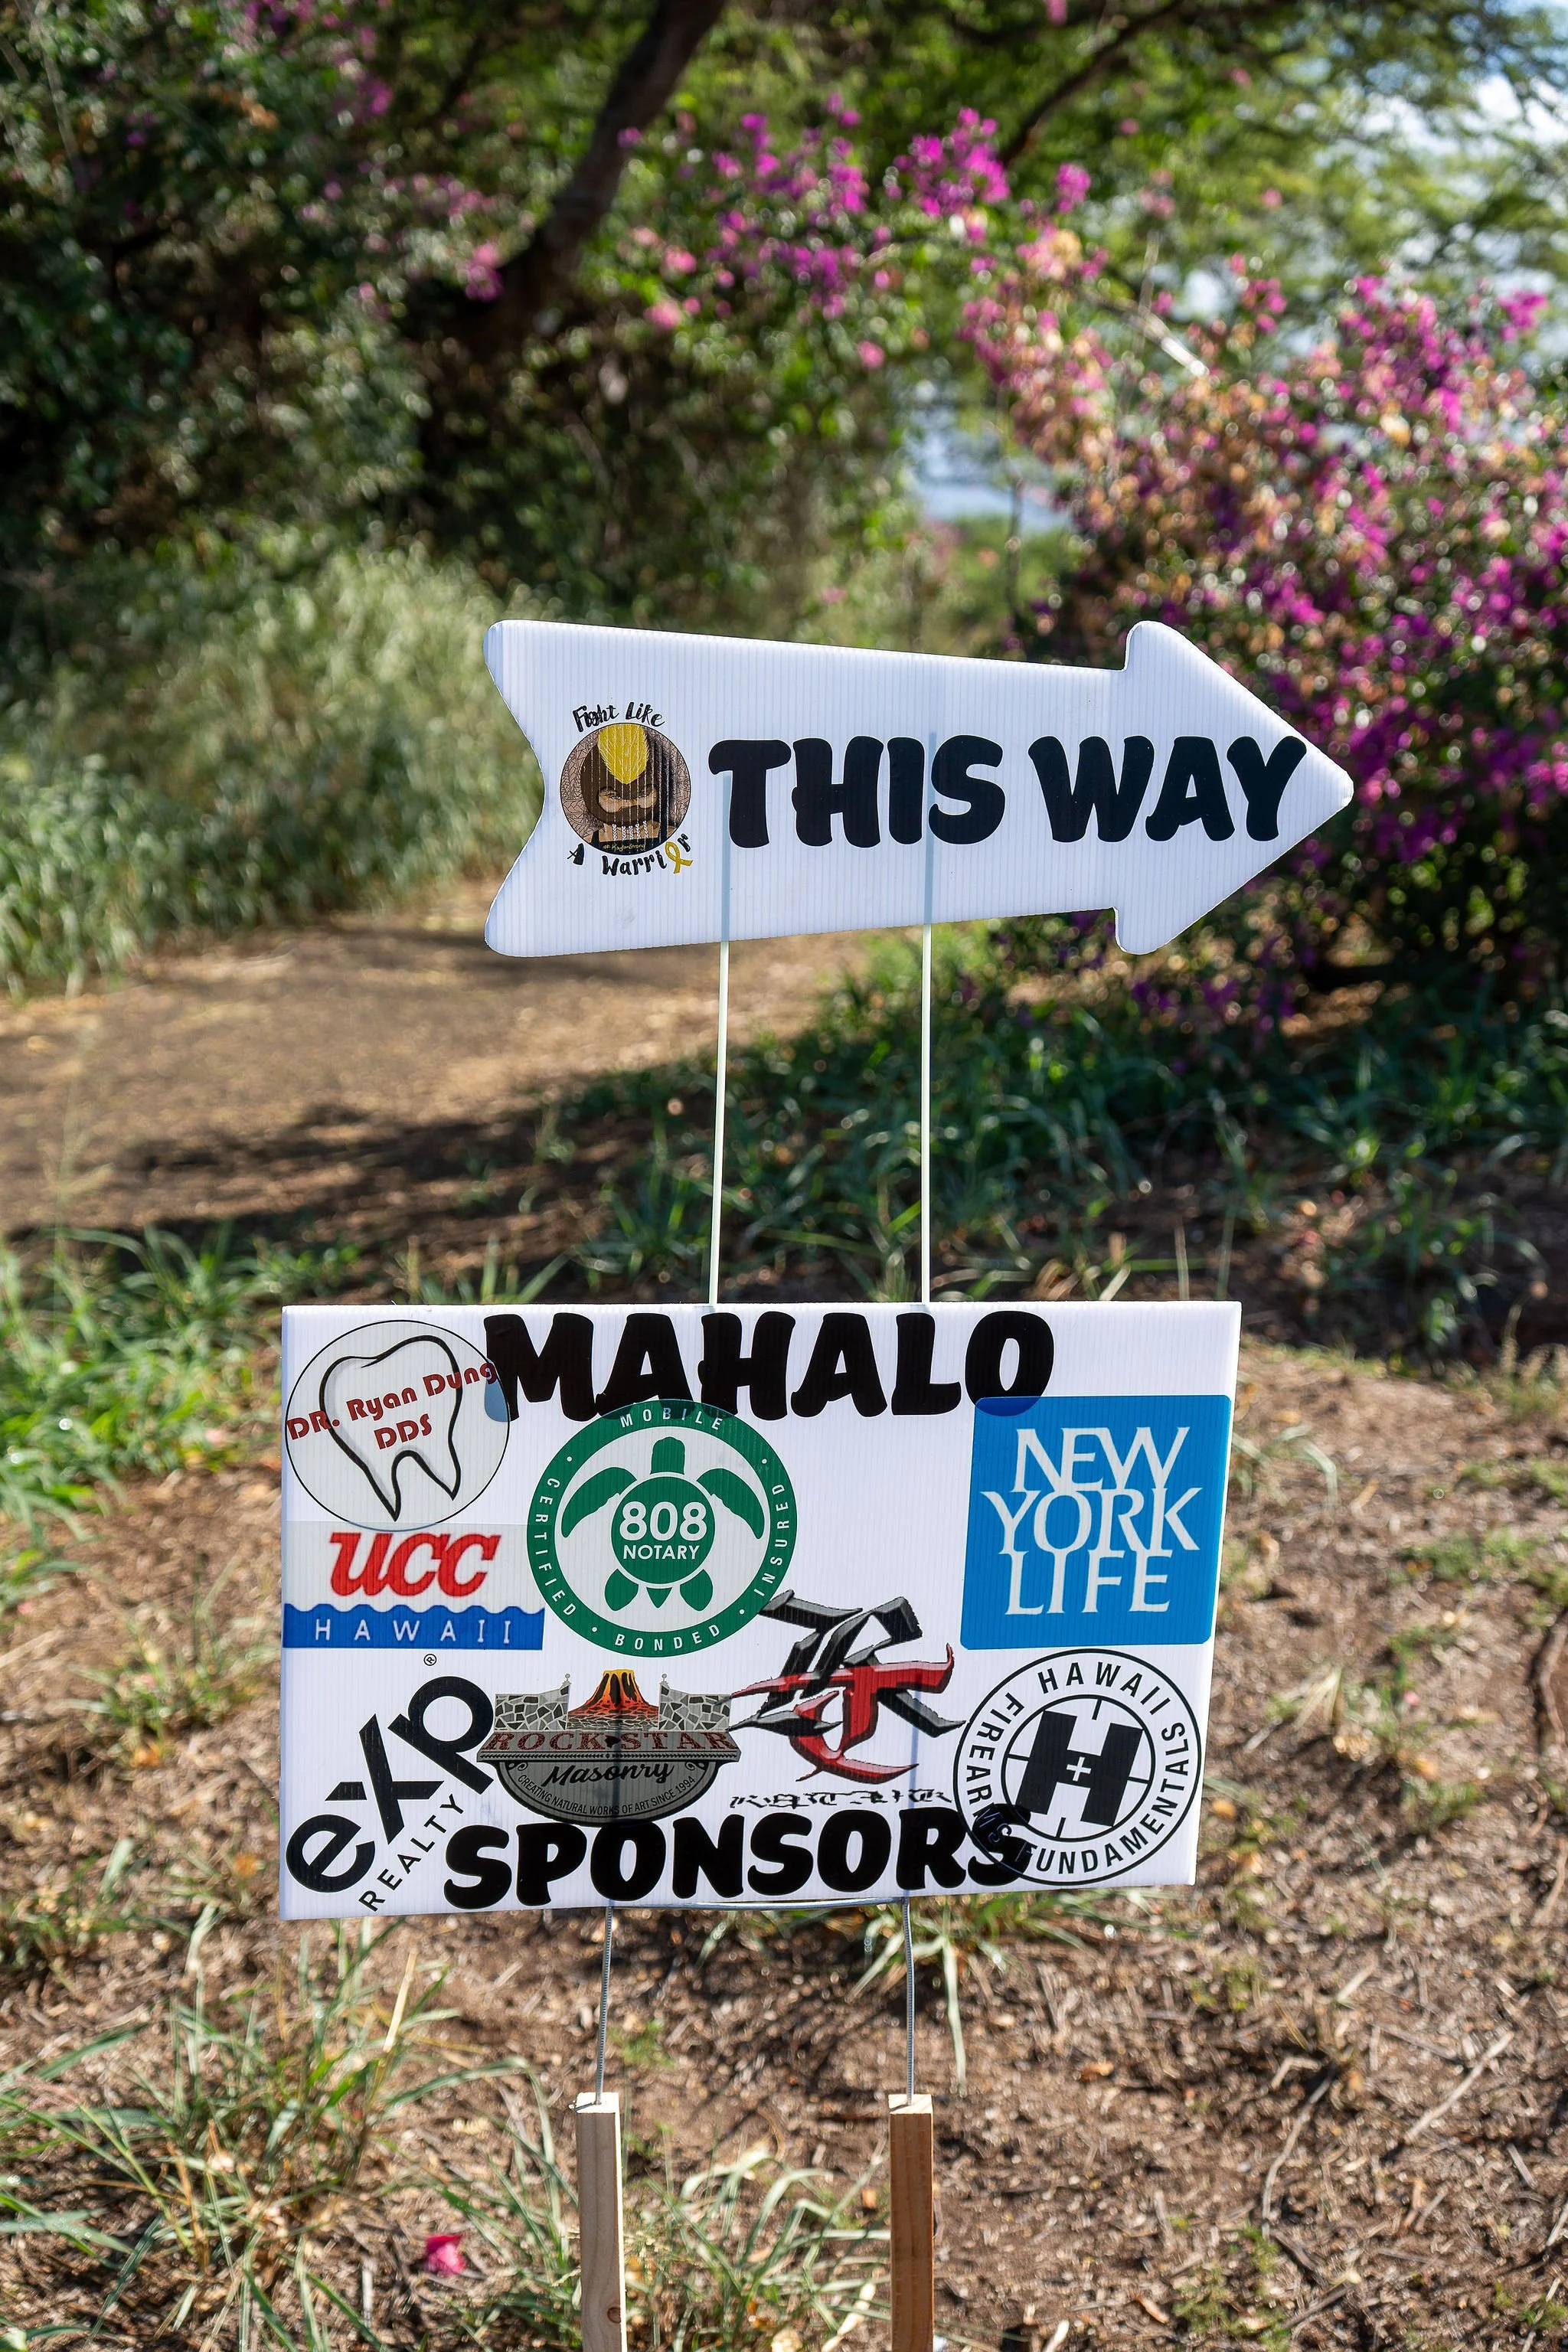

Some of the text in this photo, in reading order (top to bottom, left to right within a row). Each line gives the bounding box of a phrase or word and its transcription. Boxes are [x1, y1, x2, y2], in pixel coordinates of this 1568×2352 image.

[573, 701, 665, 733] Fight Like
[709, 736, 1307, 848] THIS WAY
[567, 843, 585, 866] A
[483, 1312, 1054, 1423] MAHALO
[286, 1362, 498, 1440] DR. Ryan Dung
[619, 1407, 724, 1430] MOBILE
[374, 1413, 433, 1450] DDS
[1012, 1426, 1190, 1492] NEW
[619, 1501, 707, 1541] 808
[756, 1483, 789, 1598] INSURED
[980, 1488, 1203, 1556] YORK
[534, 1477, 576, 1617] CERTIFIED
[622, 1544, 700, 1560] NOTARY
[1004, 1550, 1173, 1615] LIFE
[315, 1619, 511, 1645] HAWAII
[615, 1623, 720, 1651] BONDED
[1038, 1661, 1171, 1715] HAWAII
[482, 1733, 737, 1751] ROCK STAR
[518, 1773, 695, 1815] CREATING NATURAL WORKS OF ART SINCE 1994
[542, 1762, 674, 1787] Masonry
[358, 1794, 464, 1912] REALTY
[443, 1804, 1031, 1909] SPONSORS
